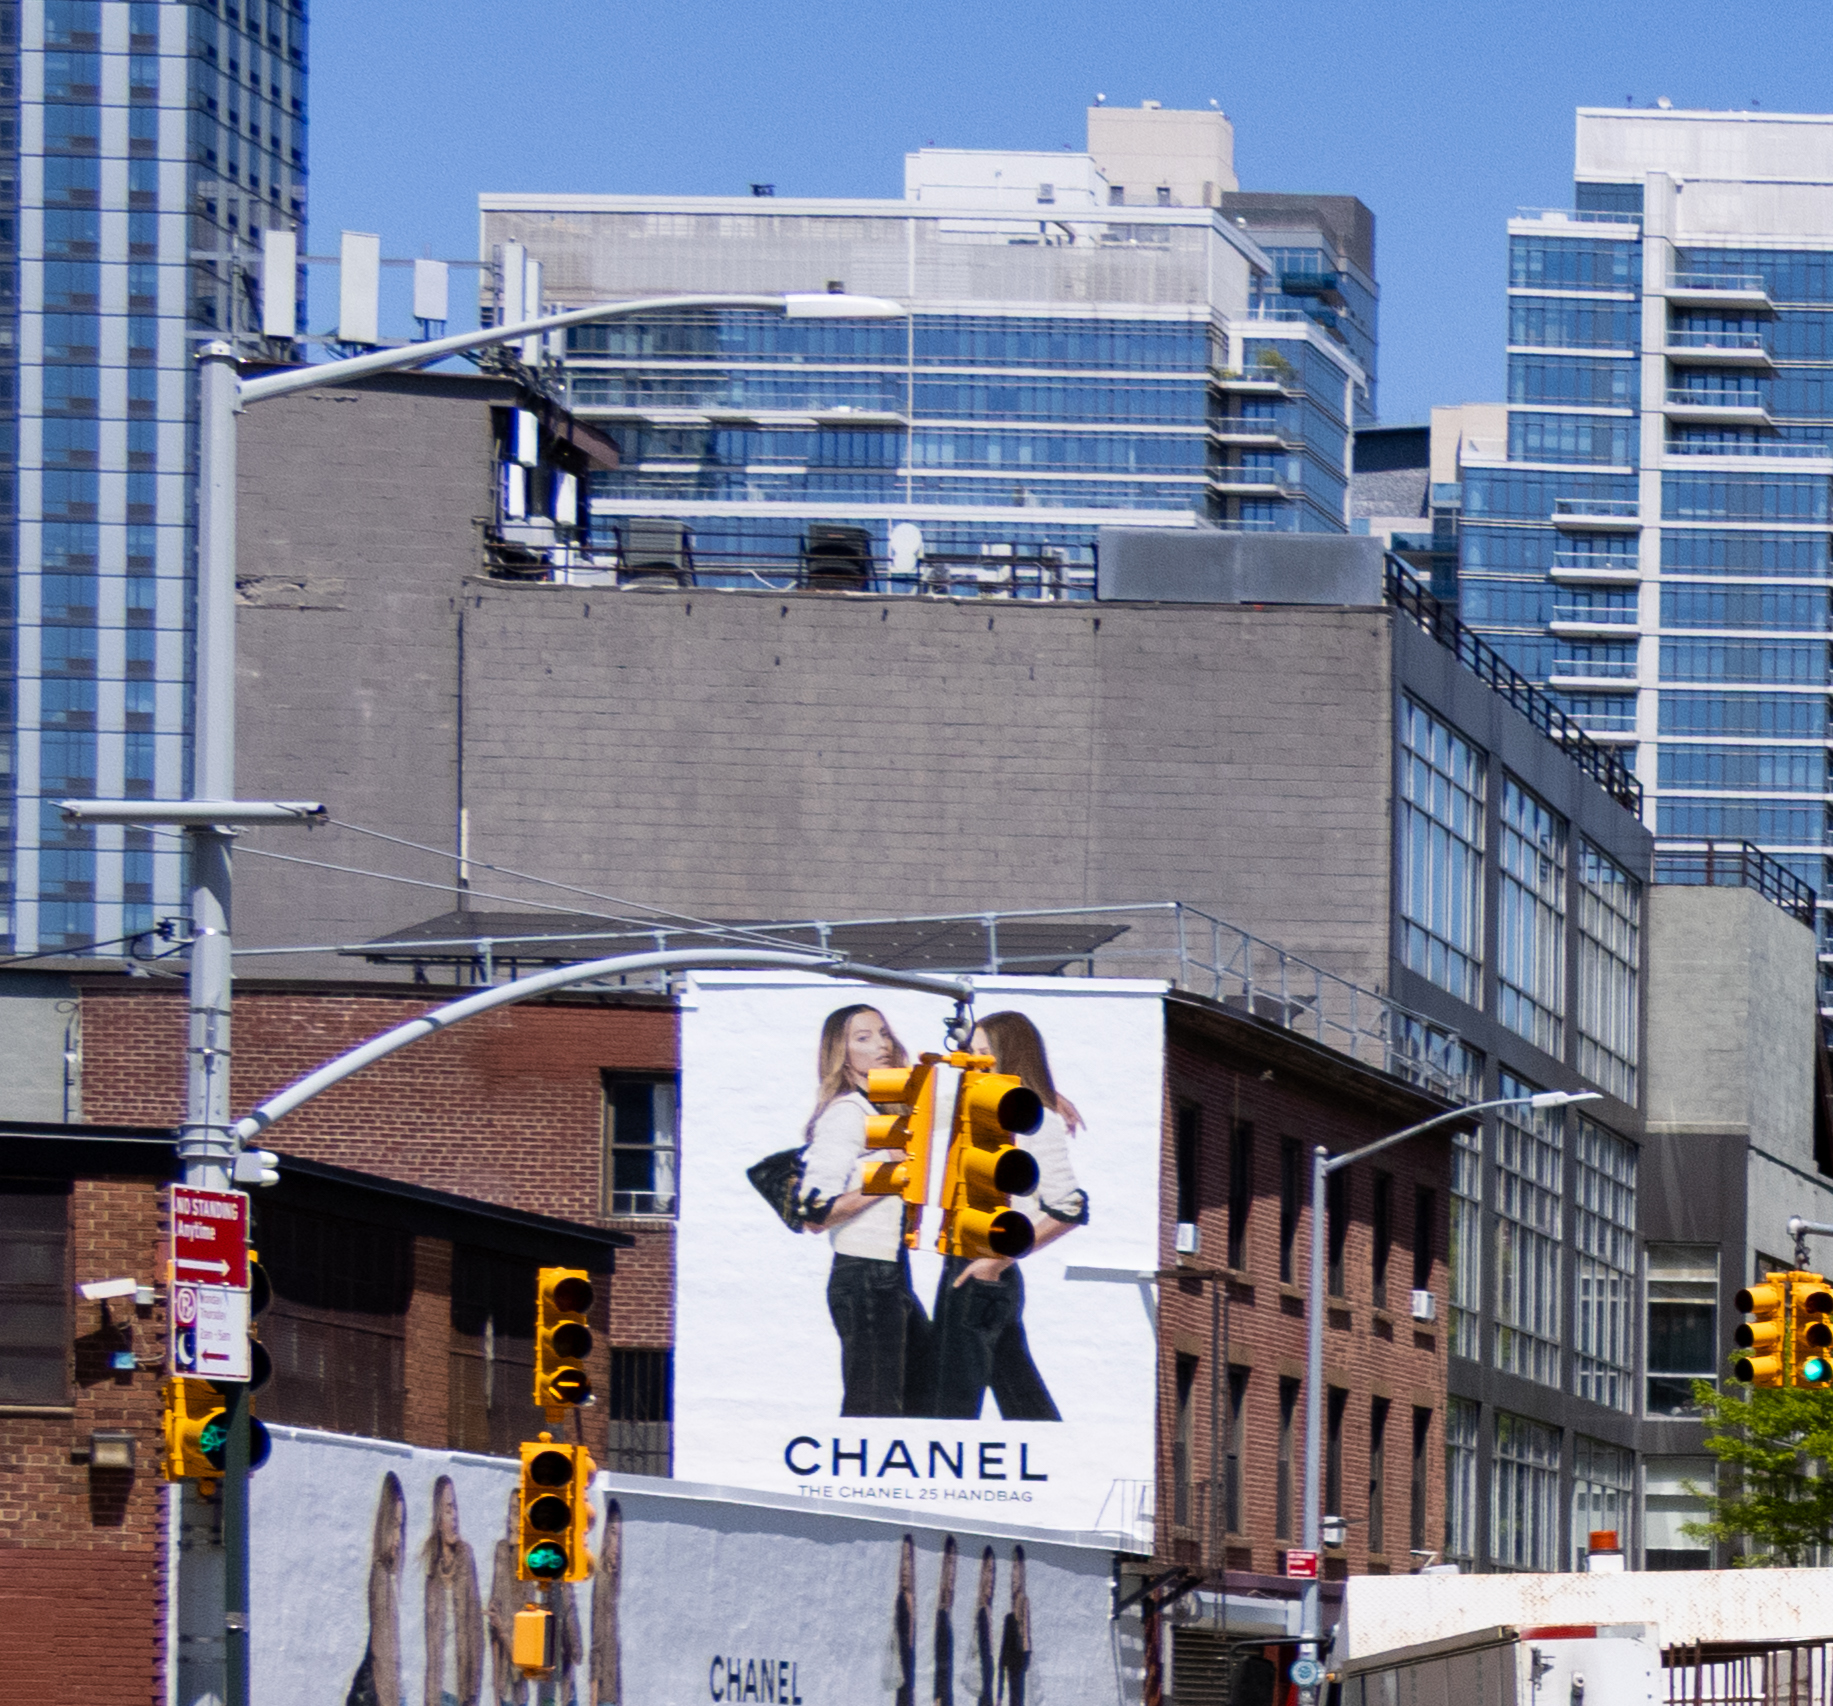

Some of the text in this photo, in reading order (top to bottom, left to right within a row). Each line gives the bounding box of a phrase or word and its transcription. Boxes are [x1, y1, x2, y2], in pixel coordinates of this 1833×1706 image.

[784, 1436, 1048, 1482] CHANEL
[798, 1485, 1032, 1502] THE CHANEL 25 HANDBAG
[709, 1655, 802, 1705] CHANEL
